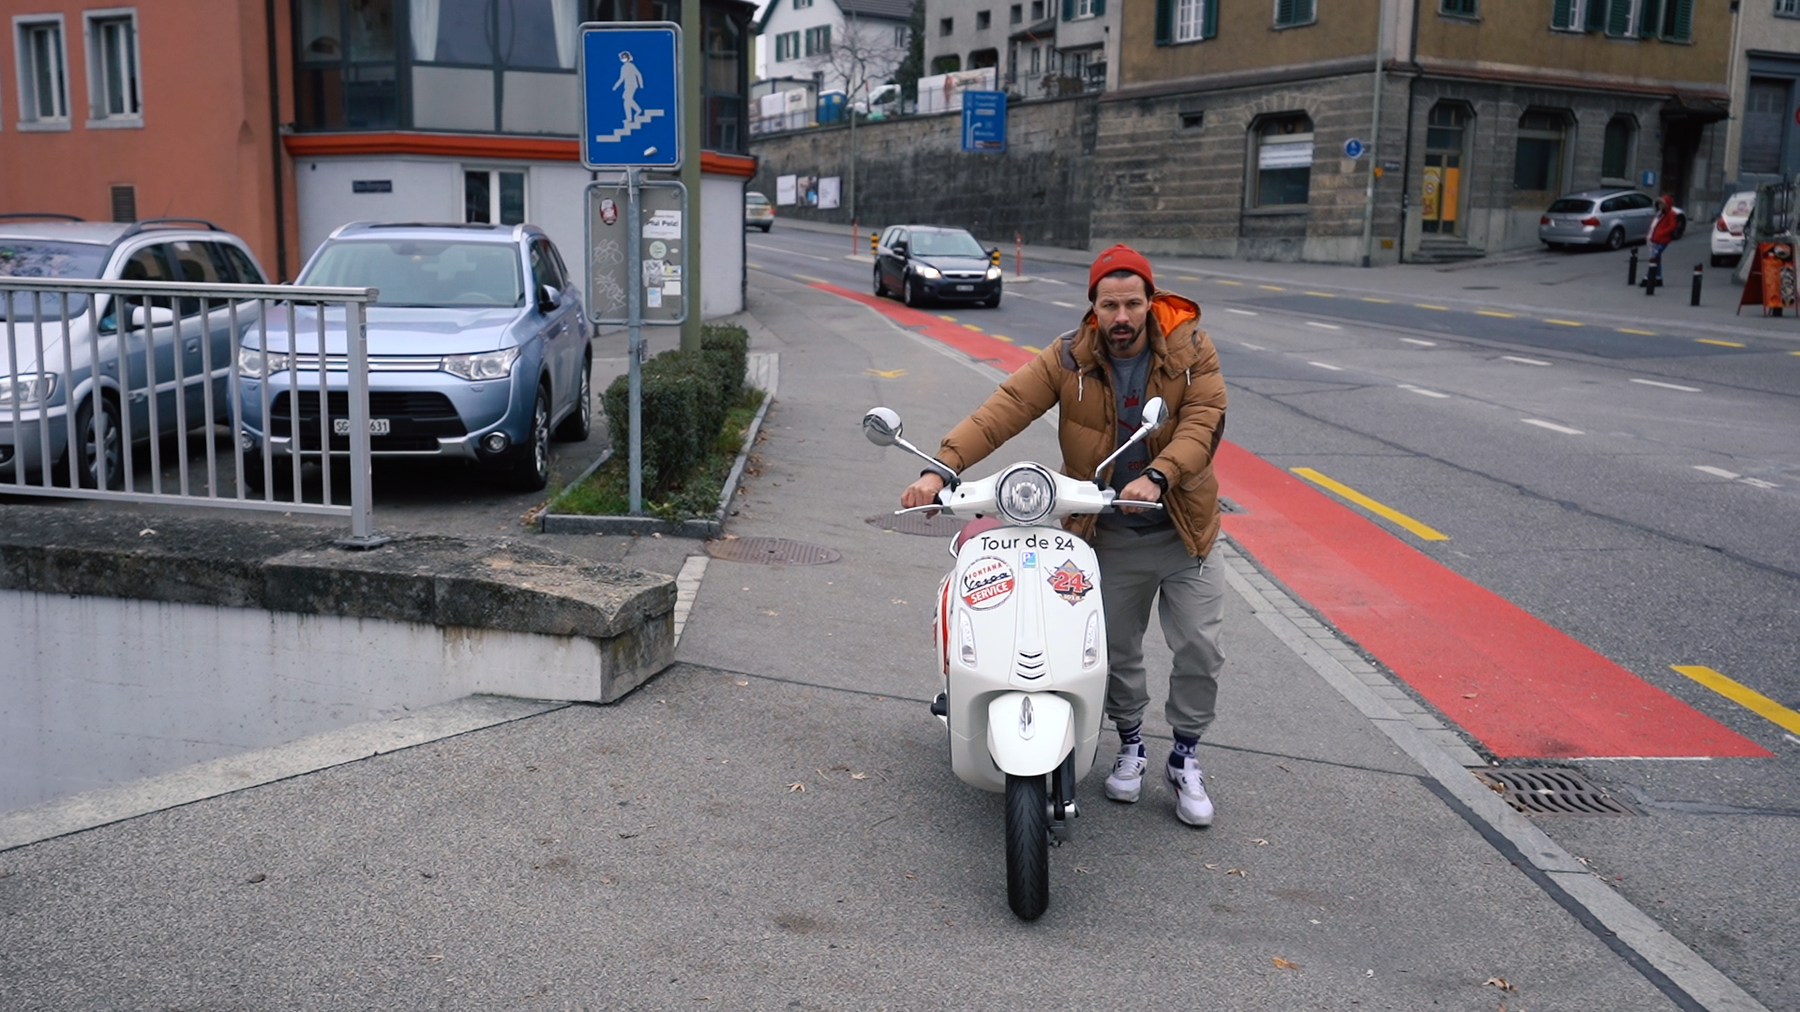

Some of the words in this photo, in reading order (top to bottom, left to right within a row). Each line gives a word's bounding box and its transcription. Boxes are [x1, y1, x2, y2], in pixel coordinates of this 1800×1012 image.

[336, 421, 349, 431] SG
[981, 536, 1020, 551] Tour
[1025, 534, 1049, 549] de
[1054, 536, 1075, 551] 24
[968, 562, 1003, 579] FONTANA
[964, 572, 1012, 593] Vespa
[1053, 571, 1086, 592] 24
[970, 582, 1009, 603] SERVICE
